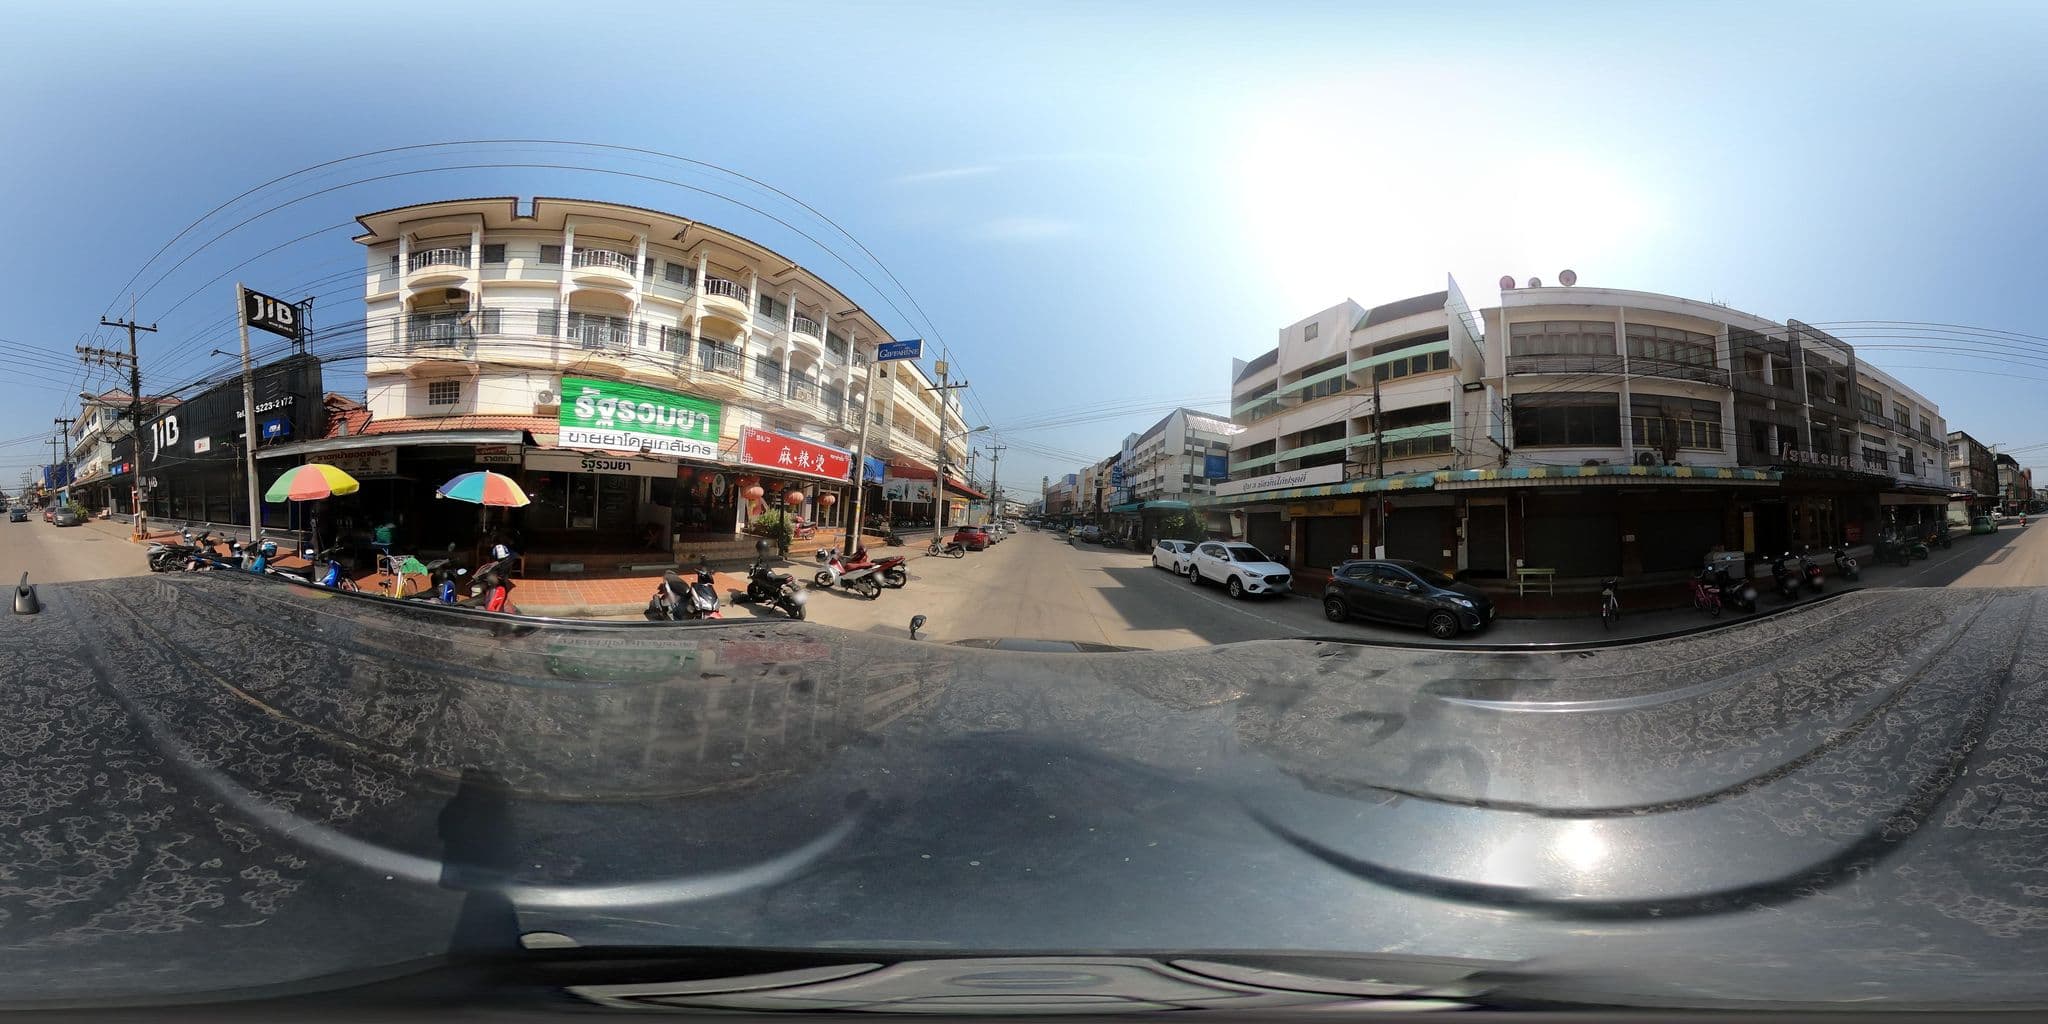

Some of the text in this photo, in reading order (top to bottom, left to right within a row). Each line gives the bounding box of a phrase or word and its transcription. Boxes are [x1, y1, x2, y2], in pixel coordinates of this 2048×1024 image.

[573, 386, 711, 434] รัฐรวมยา
[568, 432, 711, 456] ขายยาโดยเภสัชกร
